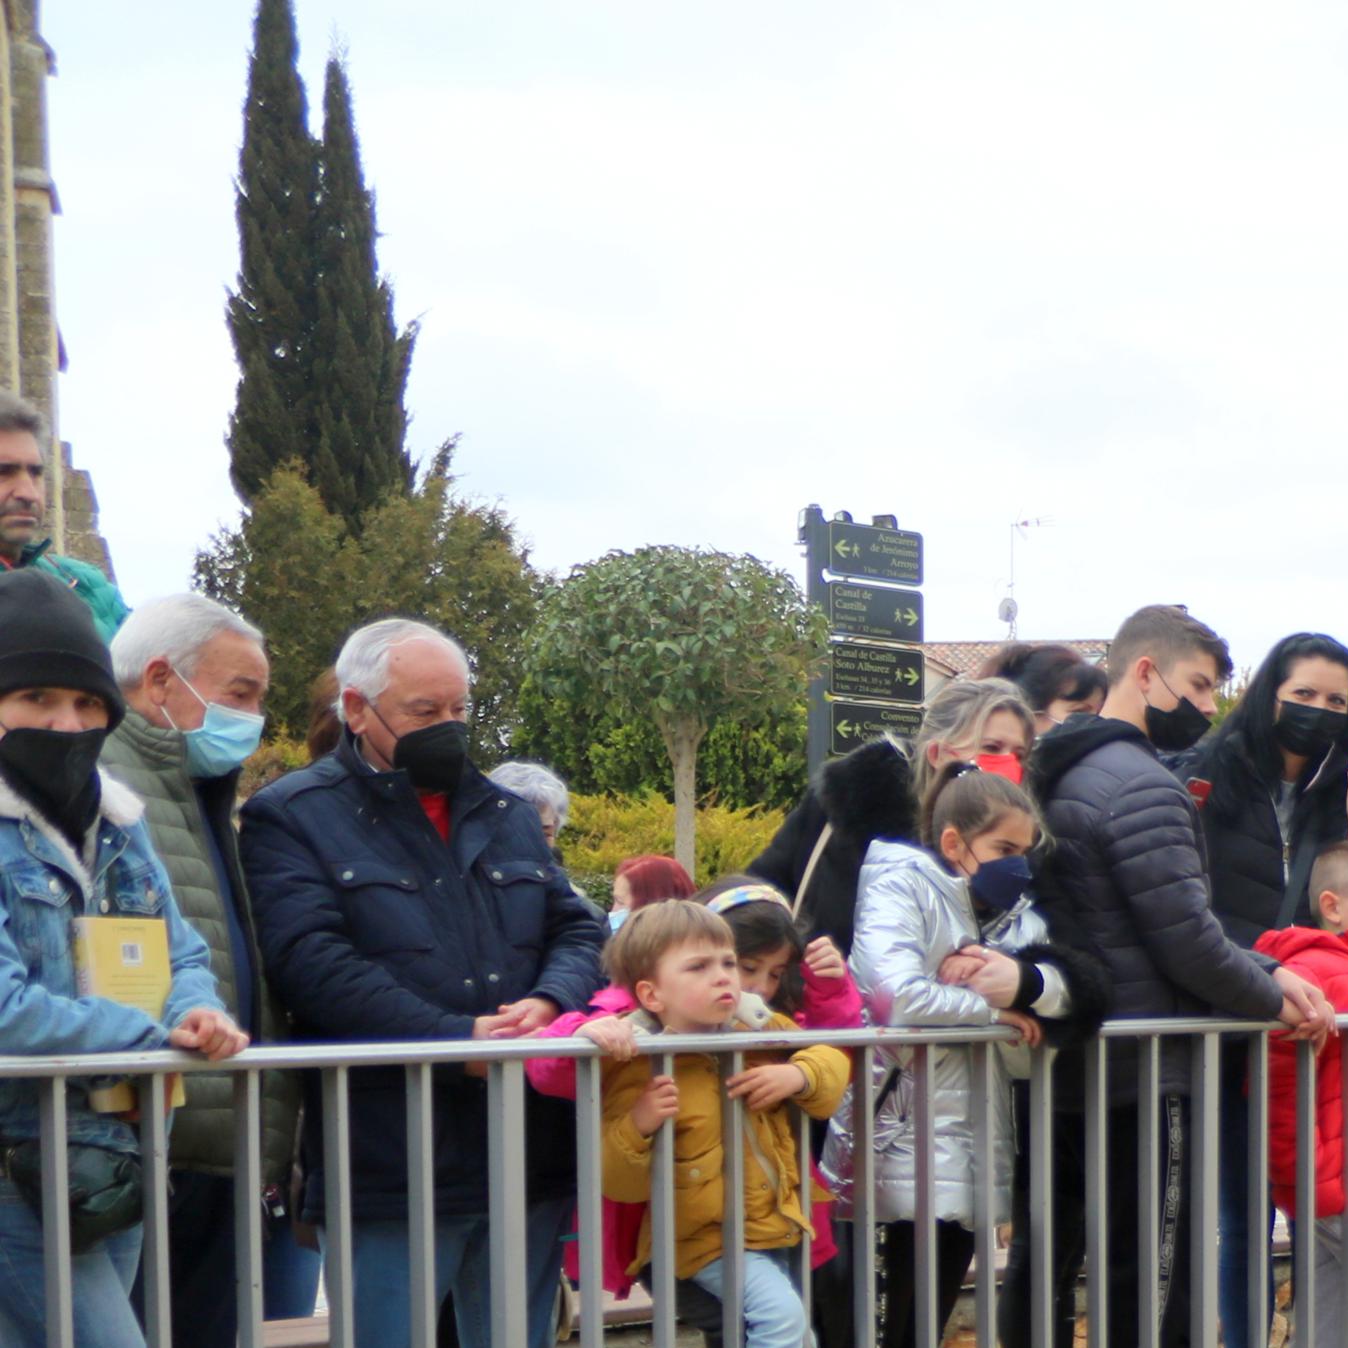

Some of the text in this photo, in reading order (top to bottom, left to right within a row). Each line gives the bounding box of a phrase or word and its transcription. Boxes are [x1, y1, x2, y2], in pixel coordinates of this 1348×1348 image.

[877, 533, 918, 547] Azucarera
[870, 543, 918, 558] de Jerónimo
[890, 558, 919, 570] Arroyo
[834, 586, 873, 600] Canal de
[834, 599, 867, 611] Castilla
[835, 647, 897, 663] Canal de Castilla
[835, 658, 891, 674] Soto Alburez
[880, 711, 920, 723] Convento
